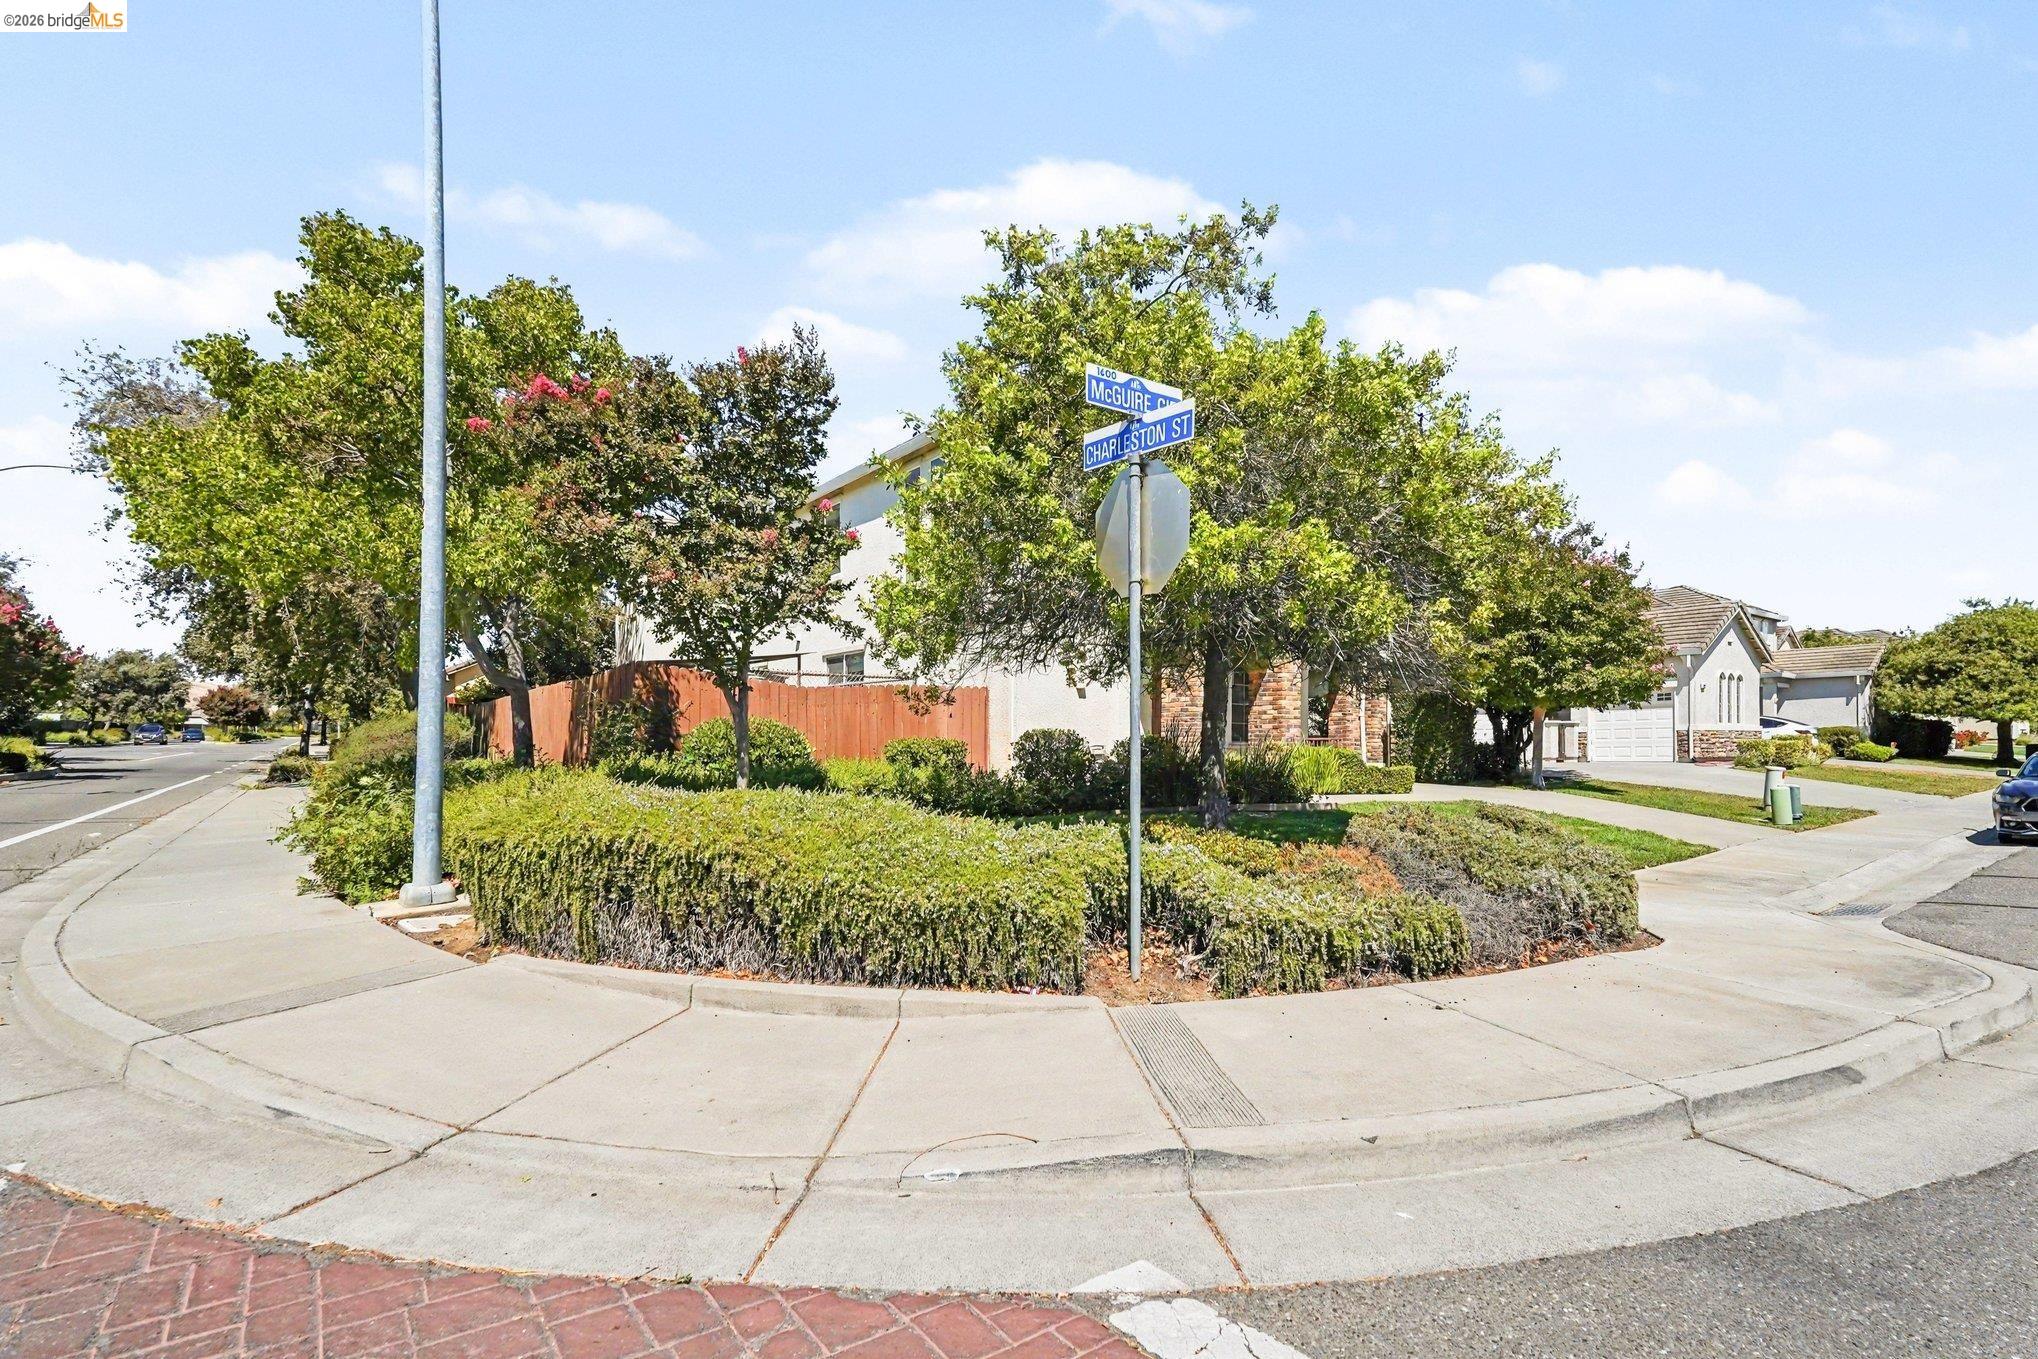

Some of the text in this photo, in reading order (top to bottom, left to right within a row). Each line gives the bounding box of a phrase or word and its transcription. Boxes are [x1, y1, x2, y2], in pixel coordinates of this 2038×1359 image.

[1091, 379, 1151, 413] McGUIRE
[1086, 414, 1191, 465] CHARLESTON ST
